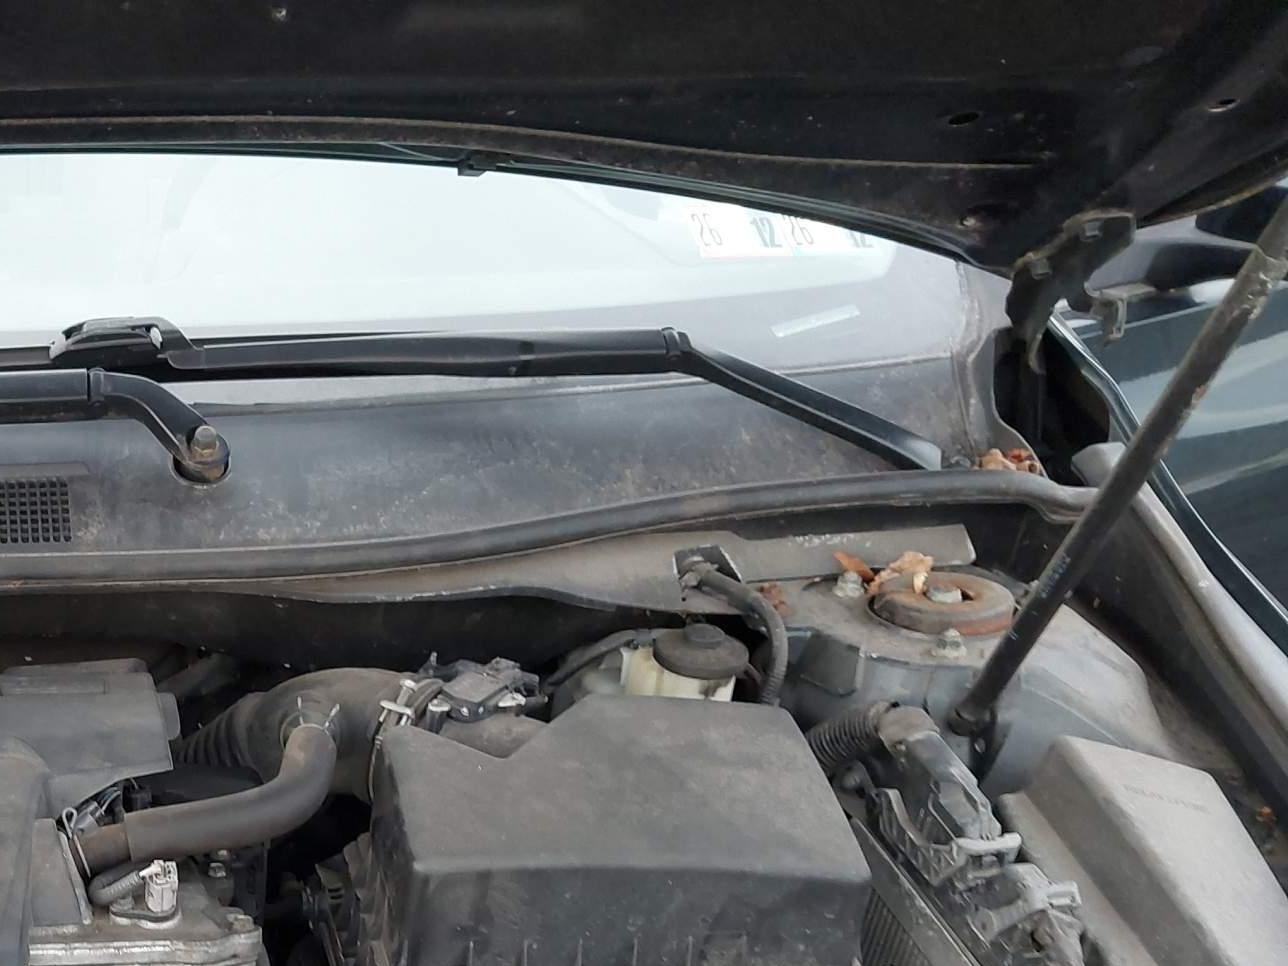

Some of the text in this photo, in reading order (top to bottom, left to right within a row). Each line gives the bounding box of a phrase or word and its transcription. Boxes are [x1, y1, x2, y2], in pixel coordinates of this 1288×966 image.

[691, 213, 783, 248] 26 12
[783, 215, 814, 246] 26
